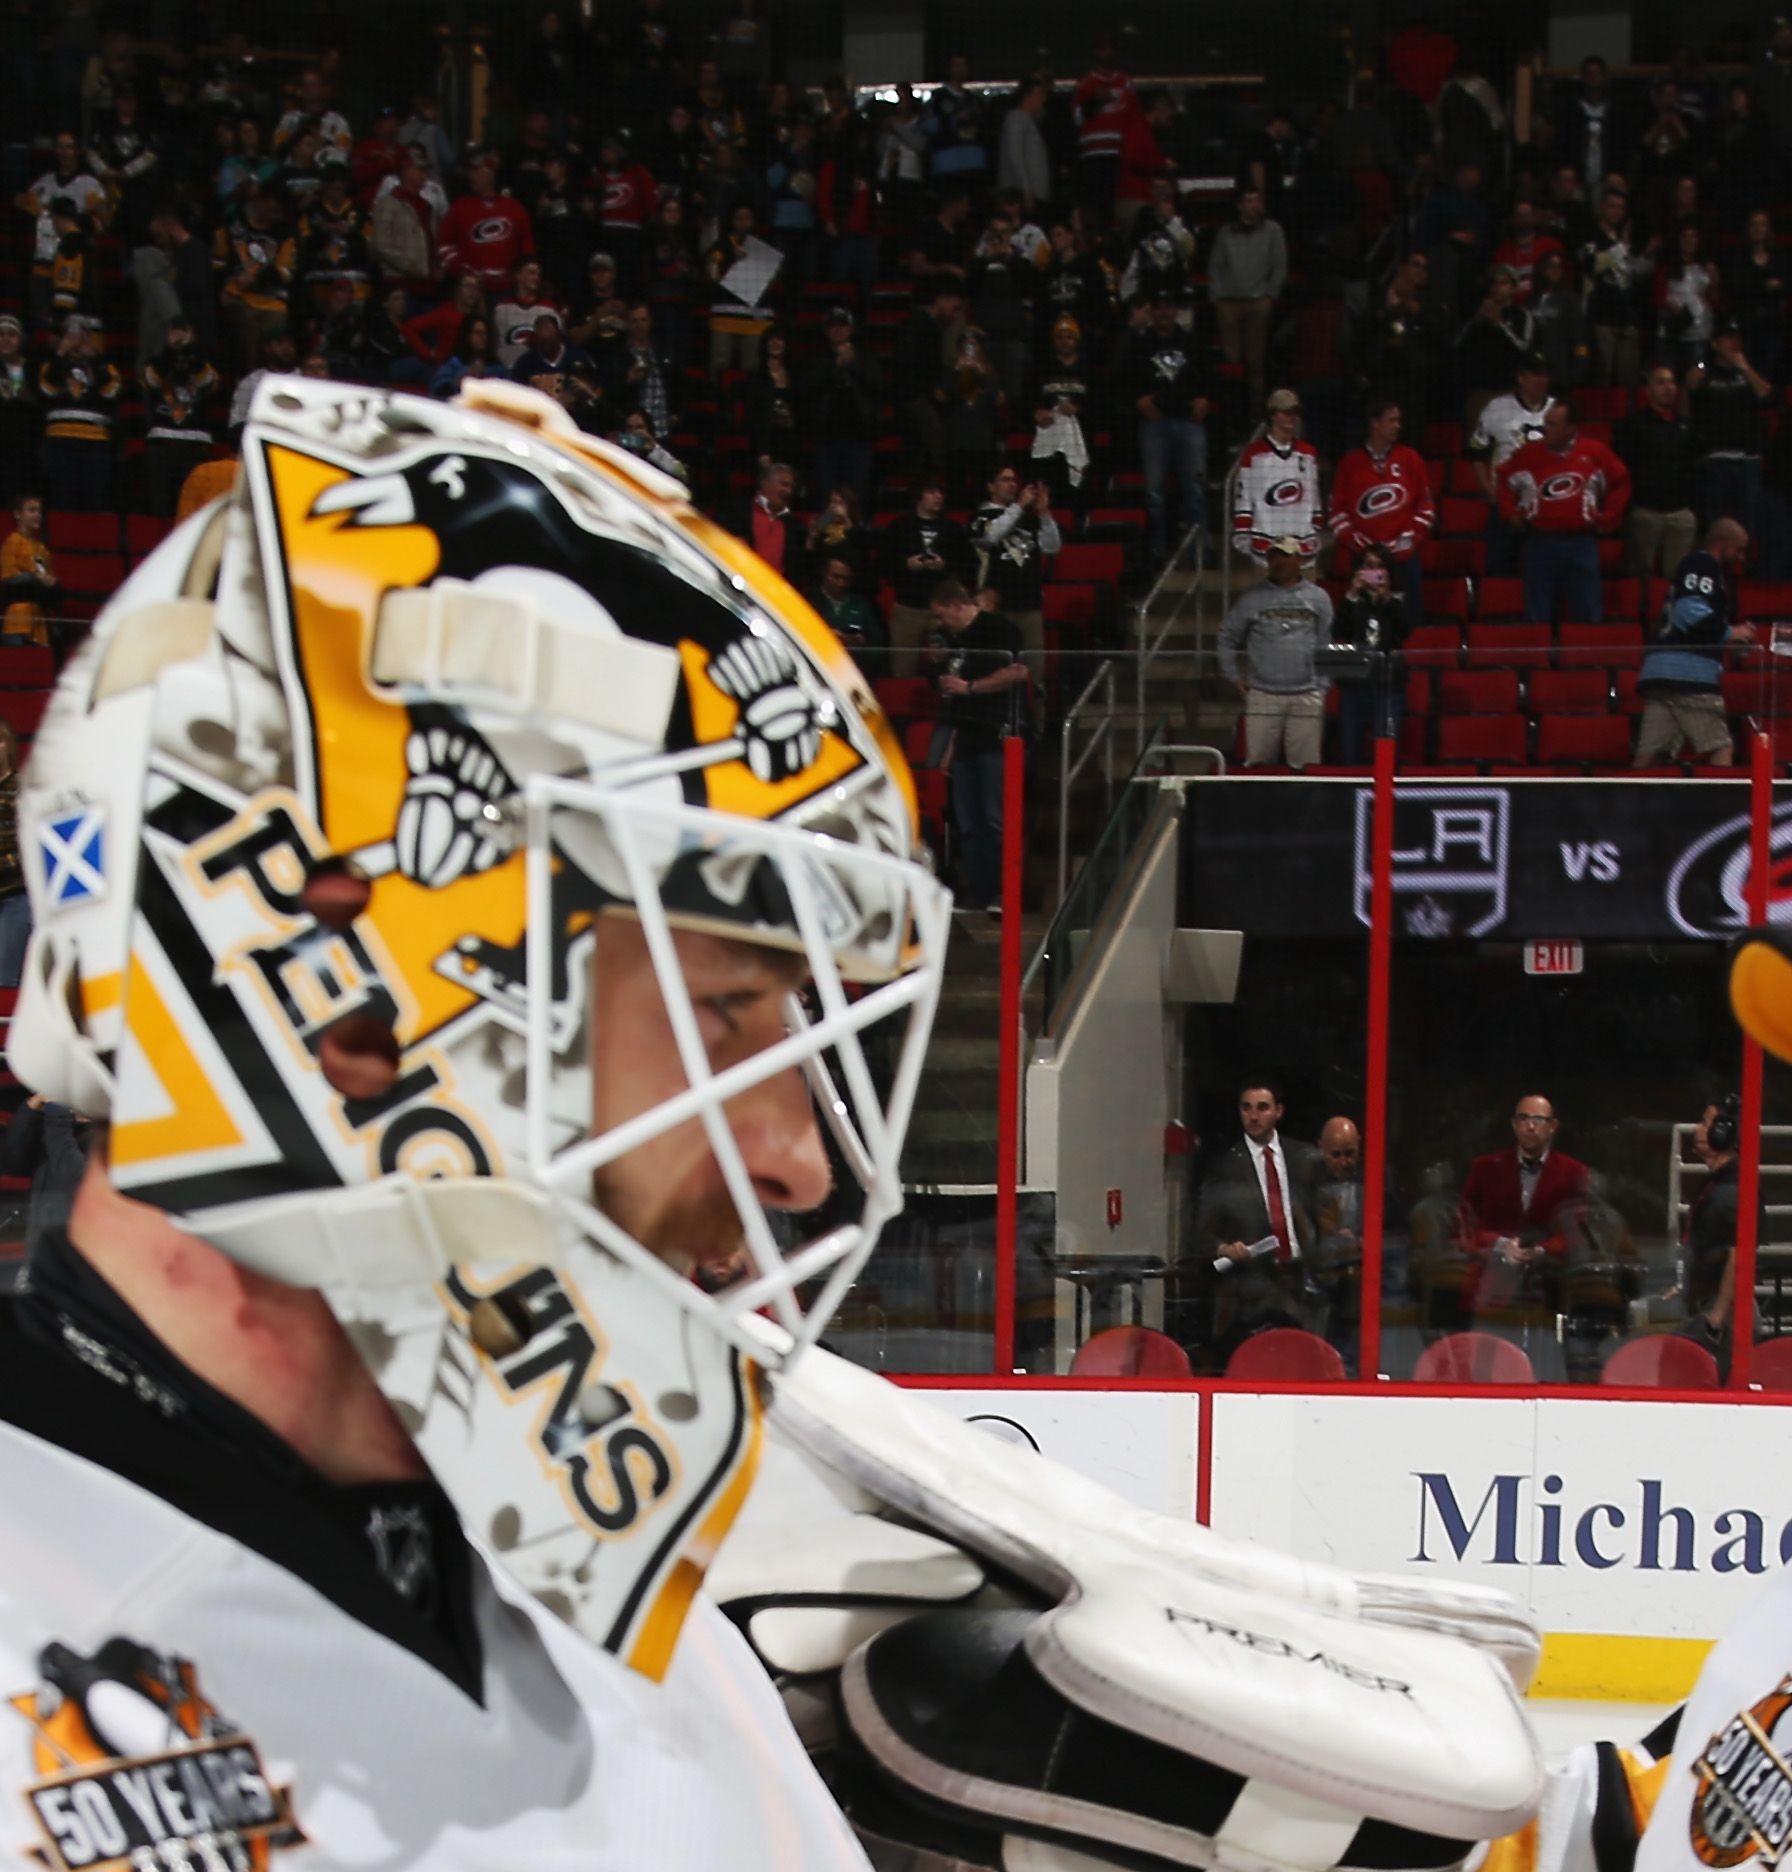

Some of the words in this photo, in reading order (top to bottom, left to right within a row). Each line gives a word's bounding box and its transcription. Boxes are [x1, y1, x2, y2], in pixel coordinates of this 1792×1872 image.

[1683, 572, 1715, 595] 66
[1532, 940, 1574, 973] EXIT
[1164, 1606, 1415, 1698] PREMIER
[1707, 1718, 1751, 1776] 50
[32, 1779, 130, 1867] 50
[111, 1747, 277, 1843] YEARS
